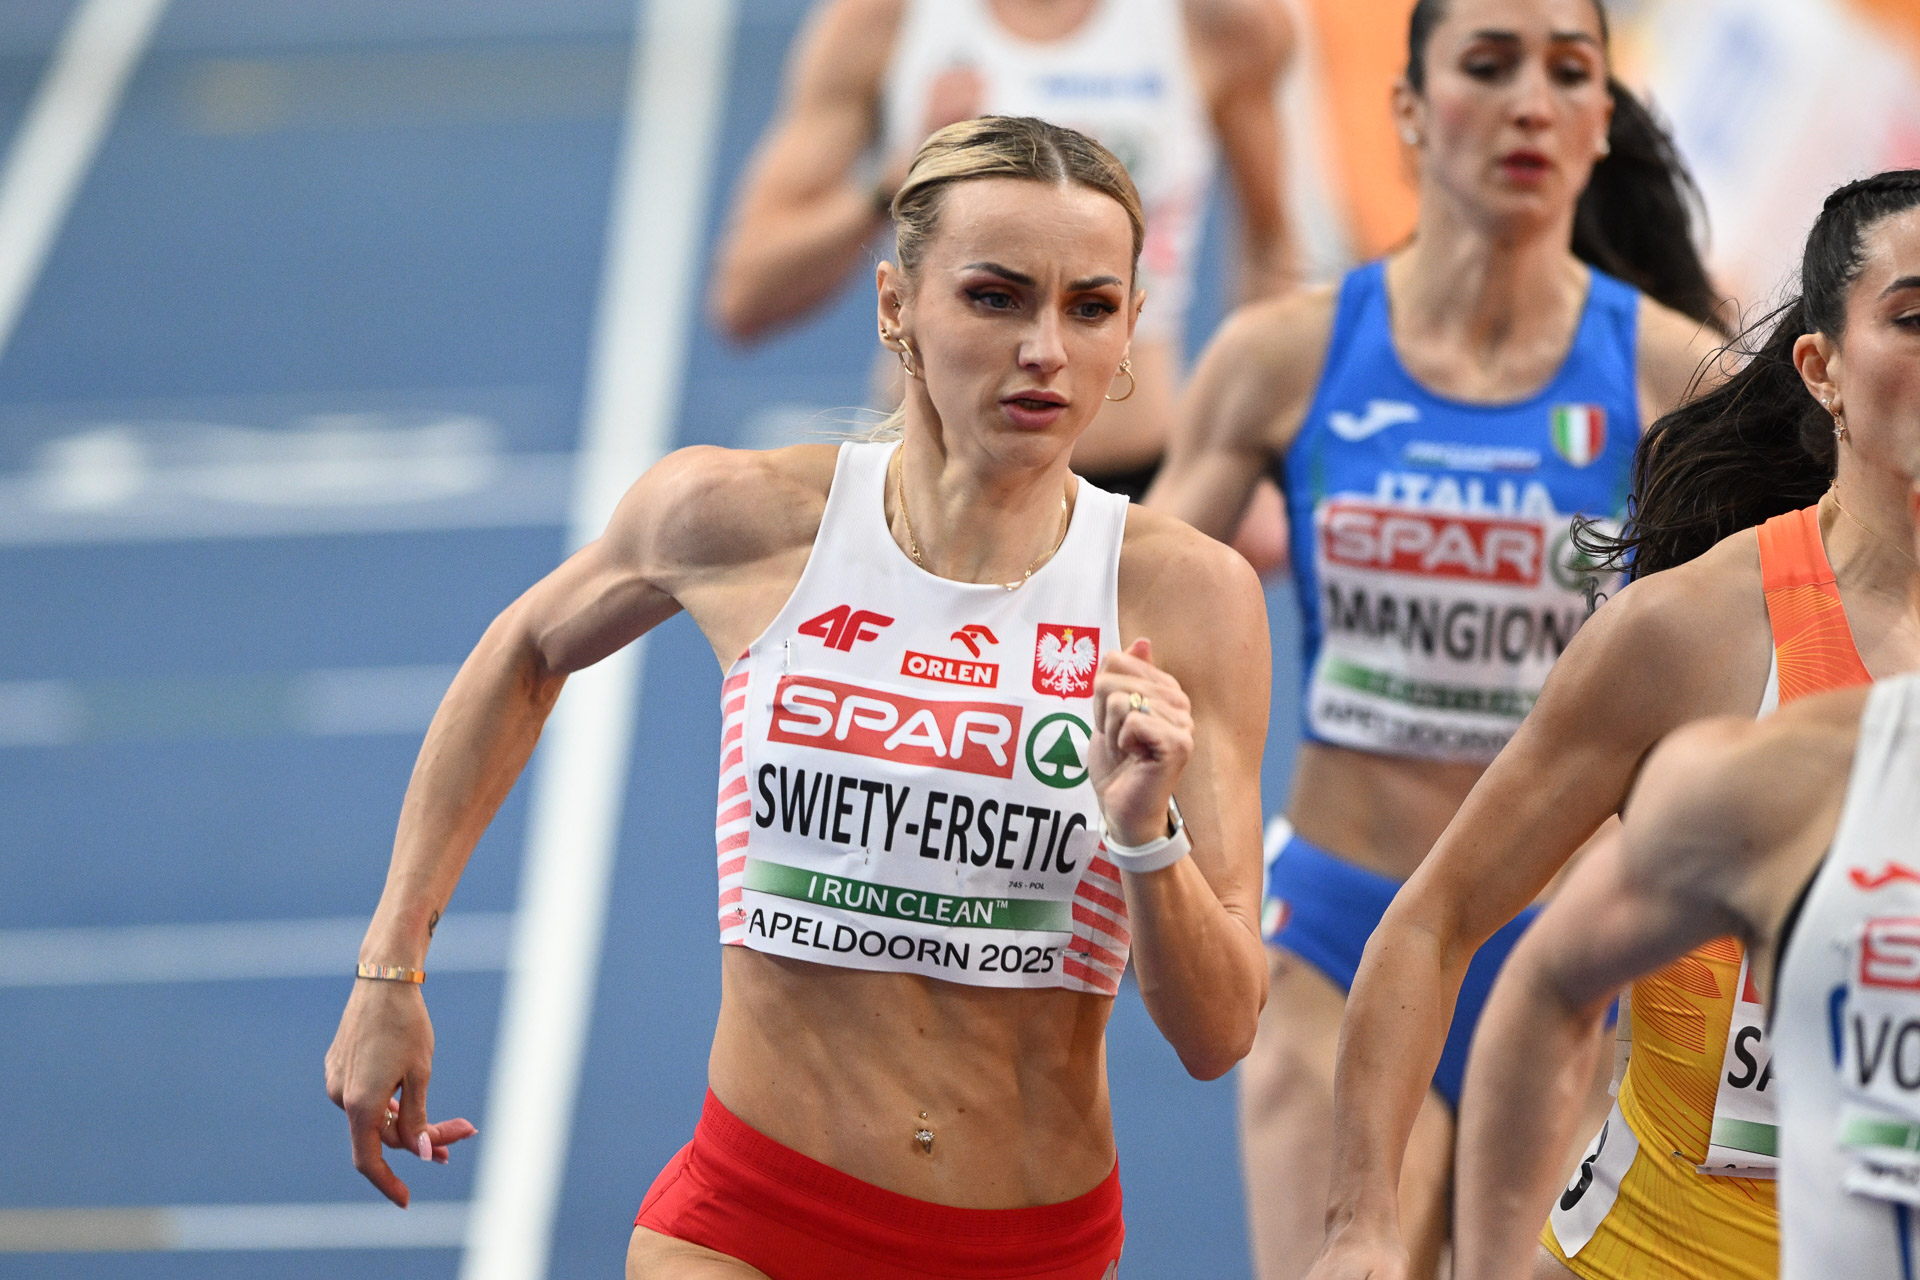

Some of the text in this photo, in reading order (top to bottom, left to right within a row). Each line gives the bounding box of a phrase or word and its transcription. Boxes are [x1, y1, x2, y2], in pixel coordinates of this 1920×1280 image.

[1377, 473, 1553, 513] ITALIA
[1327, 510, 1541, 578] SPAR
[798, 605, 895, 652] 4F
[907, 656, 993, 684] ORLEN
[779, 684, 1013, 767] SPAR
[755, 763, 1088, 874] SWIETY-ERSETIC
[807, 876, 818, 898] I
[822, 882, 890, 914] RUN
[1008, 880, 1022, 888] 745
[748, 908, 1055, 974] APELDOORN 2025
